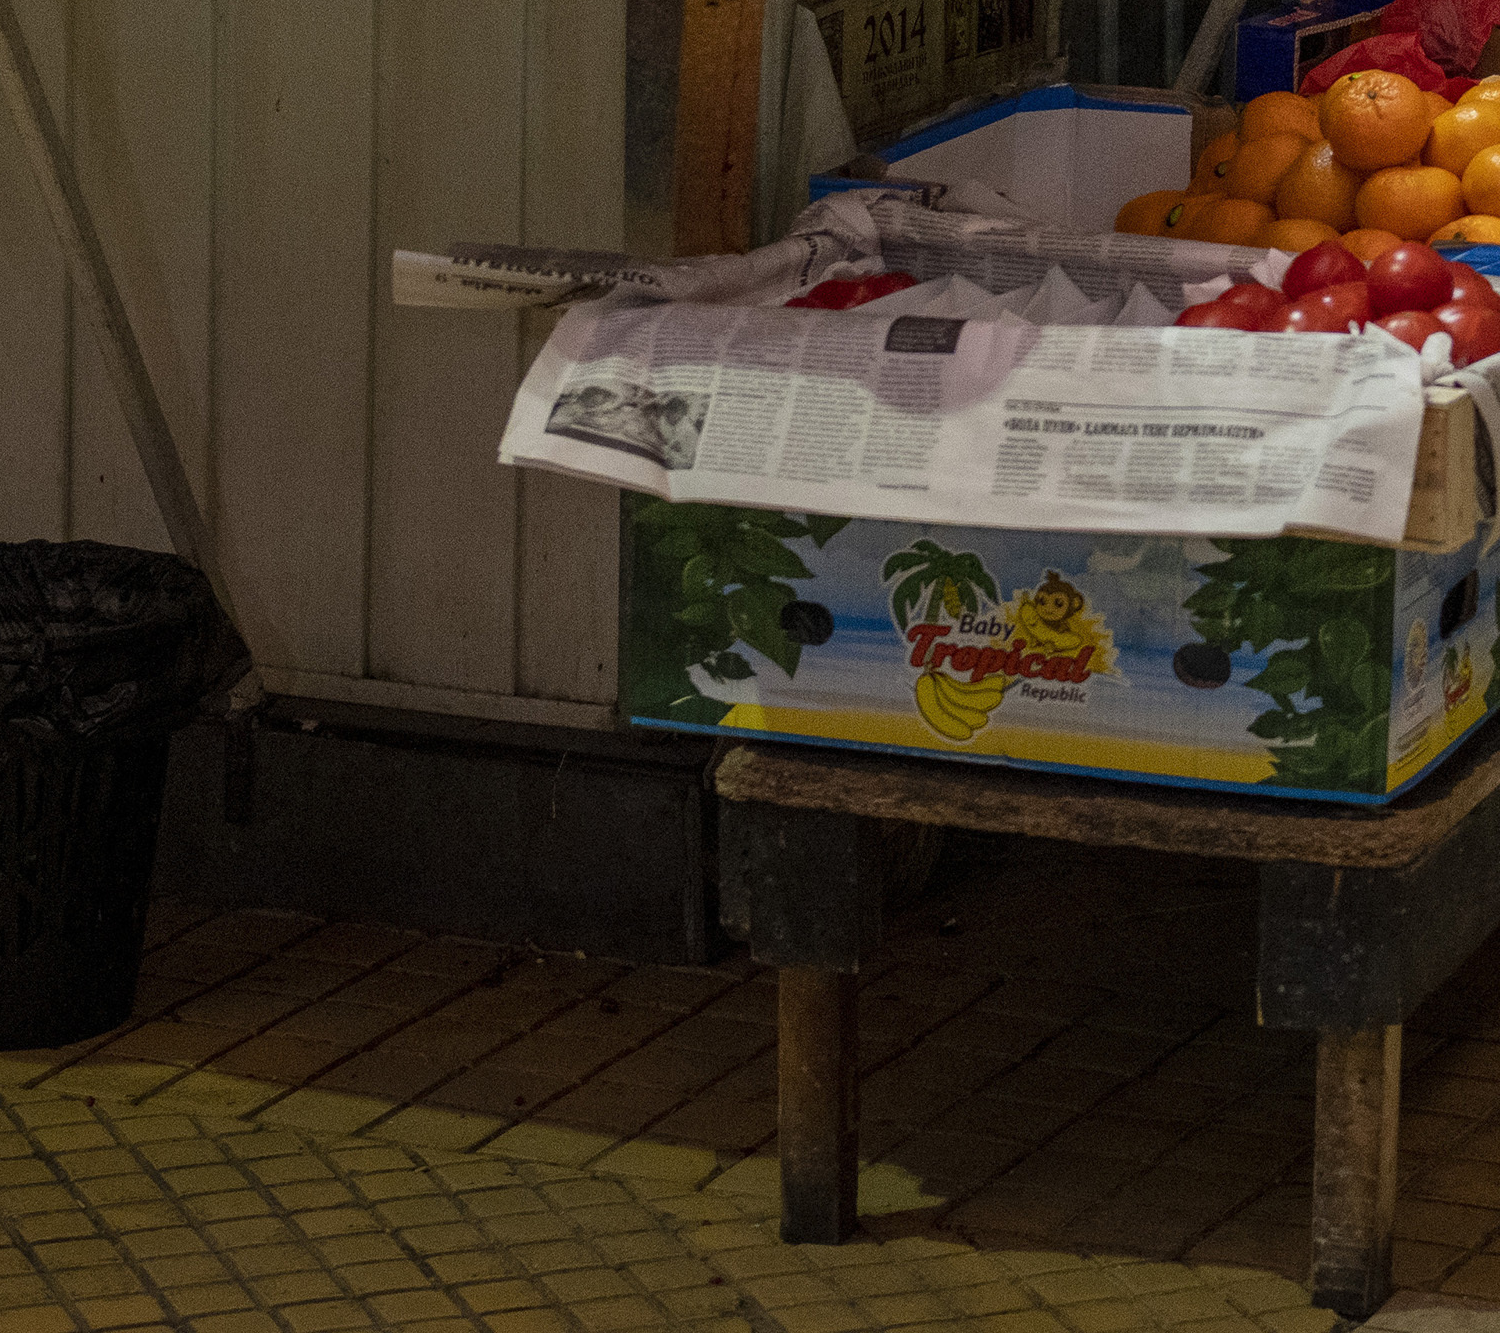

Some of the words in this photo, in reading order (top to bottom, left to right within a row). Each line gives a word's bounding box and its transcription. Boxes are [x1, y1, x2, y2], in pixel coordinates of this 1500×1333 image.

[863, 0, 927, 65] 2014
[959, 614, 1015, 642] Baby
[906, 623, 1097, 685] Tropical
[1020, 682, 1087, 704] Republic
